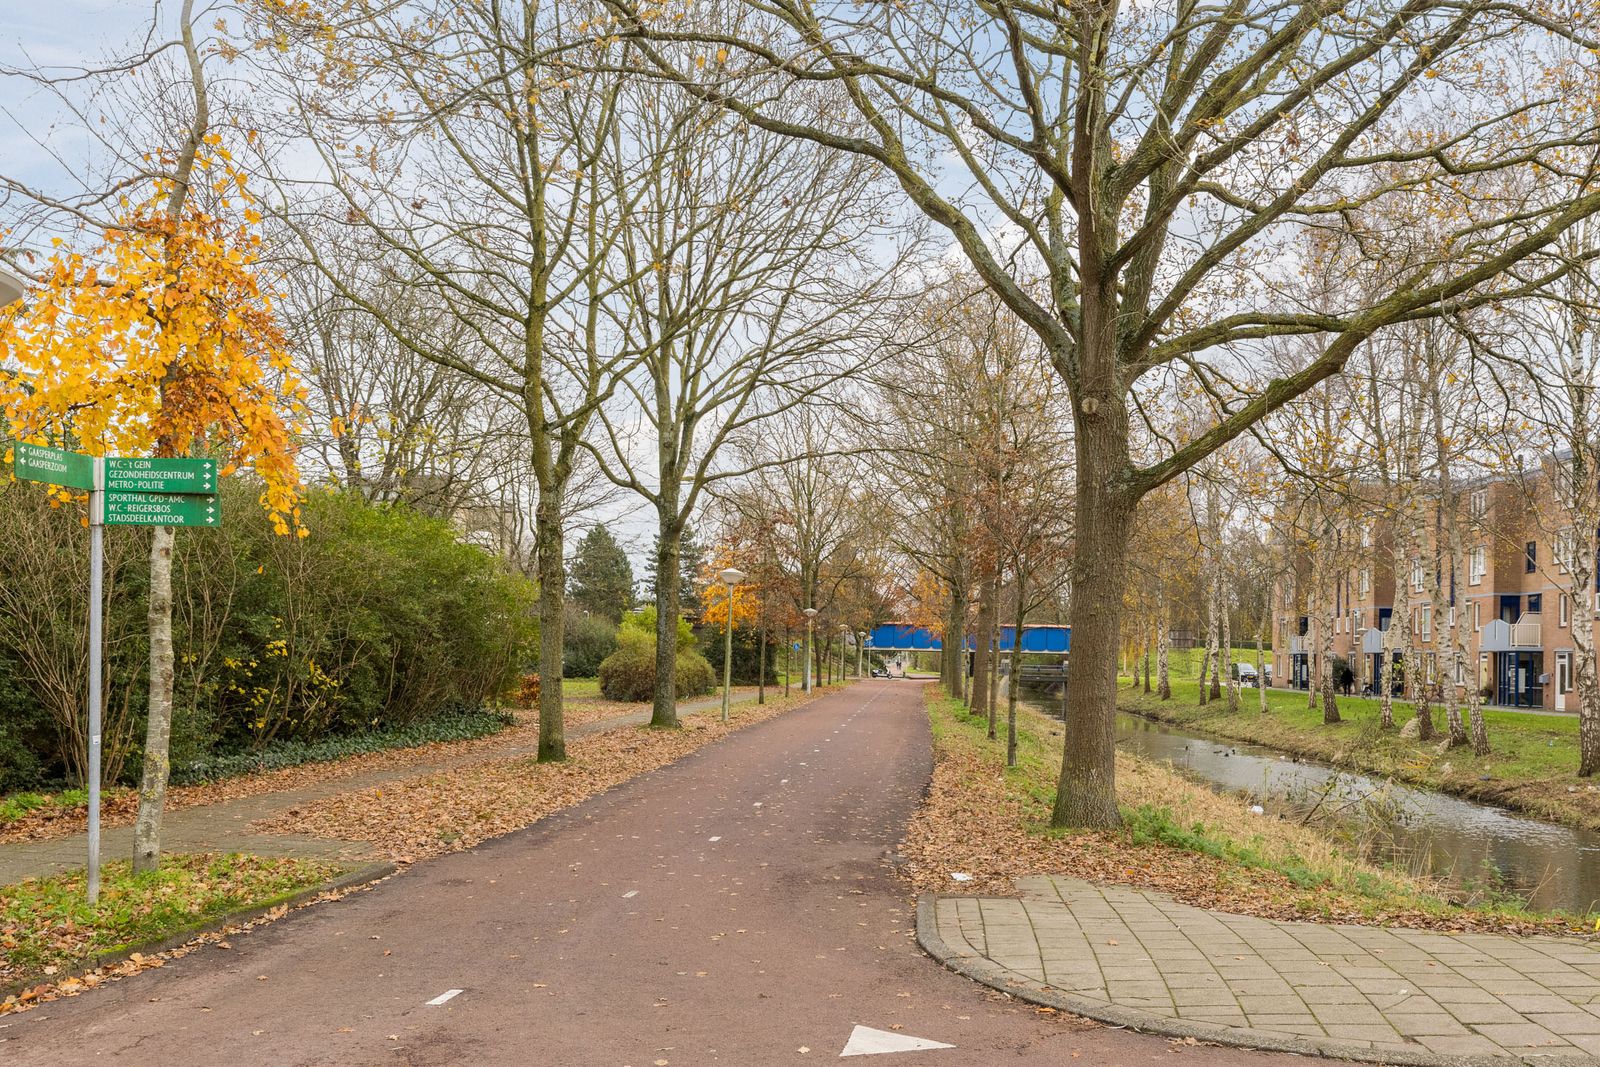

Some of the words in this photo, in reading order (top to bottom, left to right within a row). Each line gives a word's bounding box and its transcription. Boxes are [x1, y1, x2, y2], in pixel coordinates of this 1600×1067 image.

[28, 447, 63, 462] GAASPERPLAS
[28, 458, 67, 472] GAASPERZOOM
[134, 460, 152, 469] GEIN
[108, 470, 195, 480] GEZONDHEIDSCENTRUM
[108, 481, 165, 490] METRO-POLITIE
[108, 494, 147, 503] SPORTHAL
[108, 514, 185, 524] STADSDEELKANTOOR
